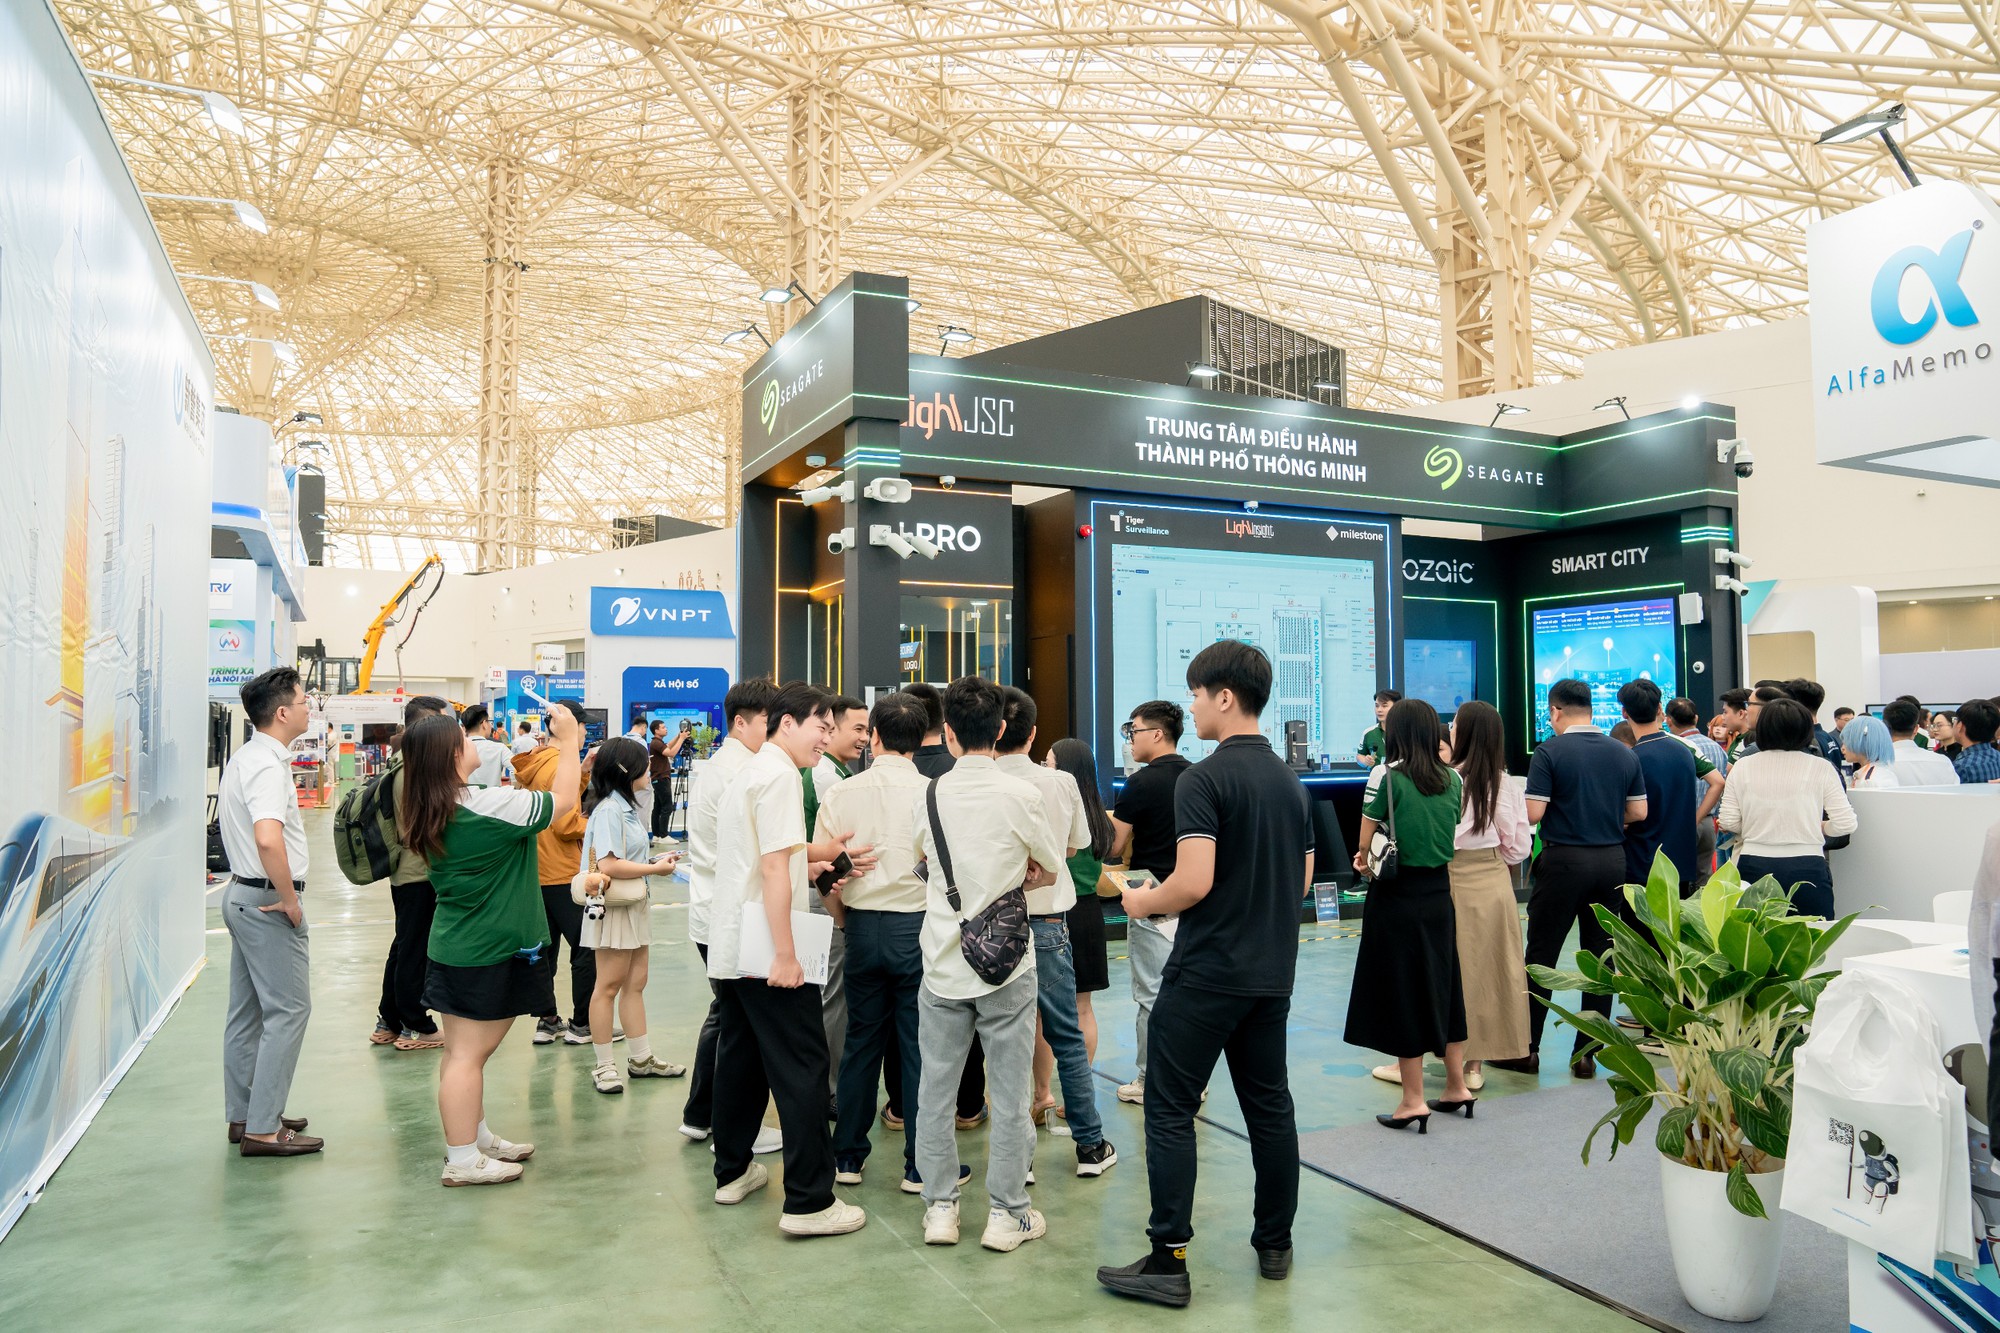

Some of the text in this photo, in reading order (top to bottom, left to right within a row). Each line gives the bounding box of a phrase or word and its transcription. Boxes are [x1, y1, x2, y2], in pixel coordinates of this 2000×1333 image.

[1827, 342, 1992, 396] AlfaMemo
[780, 359, 823, 407] SEAGATE
[1145, 416, 1357, 456] TRUNG TÂM ĐIỀU HÀNH
[1135, 441, 1367, 482] THÀNH PHỐ THÔNG MINH
[1467, 464, 1544, 486] SEAGATE
[1125, 515, 1145, 525] Tiger
[1125, 525, 1170, 536] Surveillance
[900, 522, 981, 552] PRO
[1340, 529, 1383, 541] milestone
[1402, 559, 1473, 584] ozaic
[1551, 546, 1650, 575] SMART CITY
[643, 608, 711, 622] VNPT
[653, 678, 699, 691] XÃ HỘI SỐ
